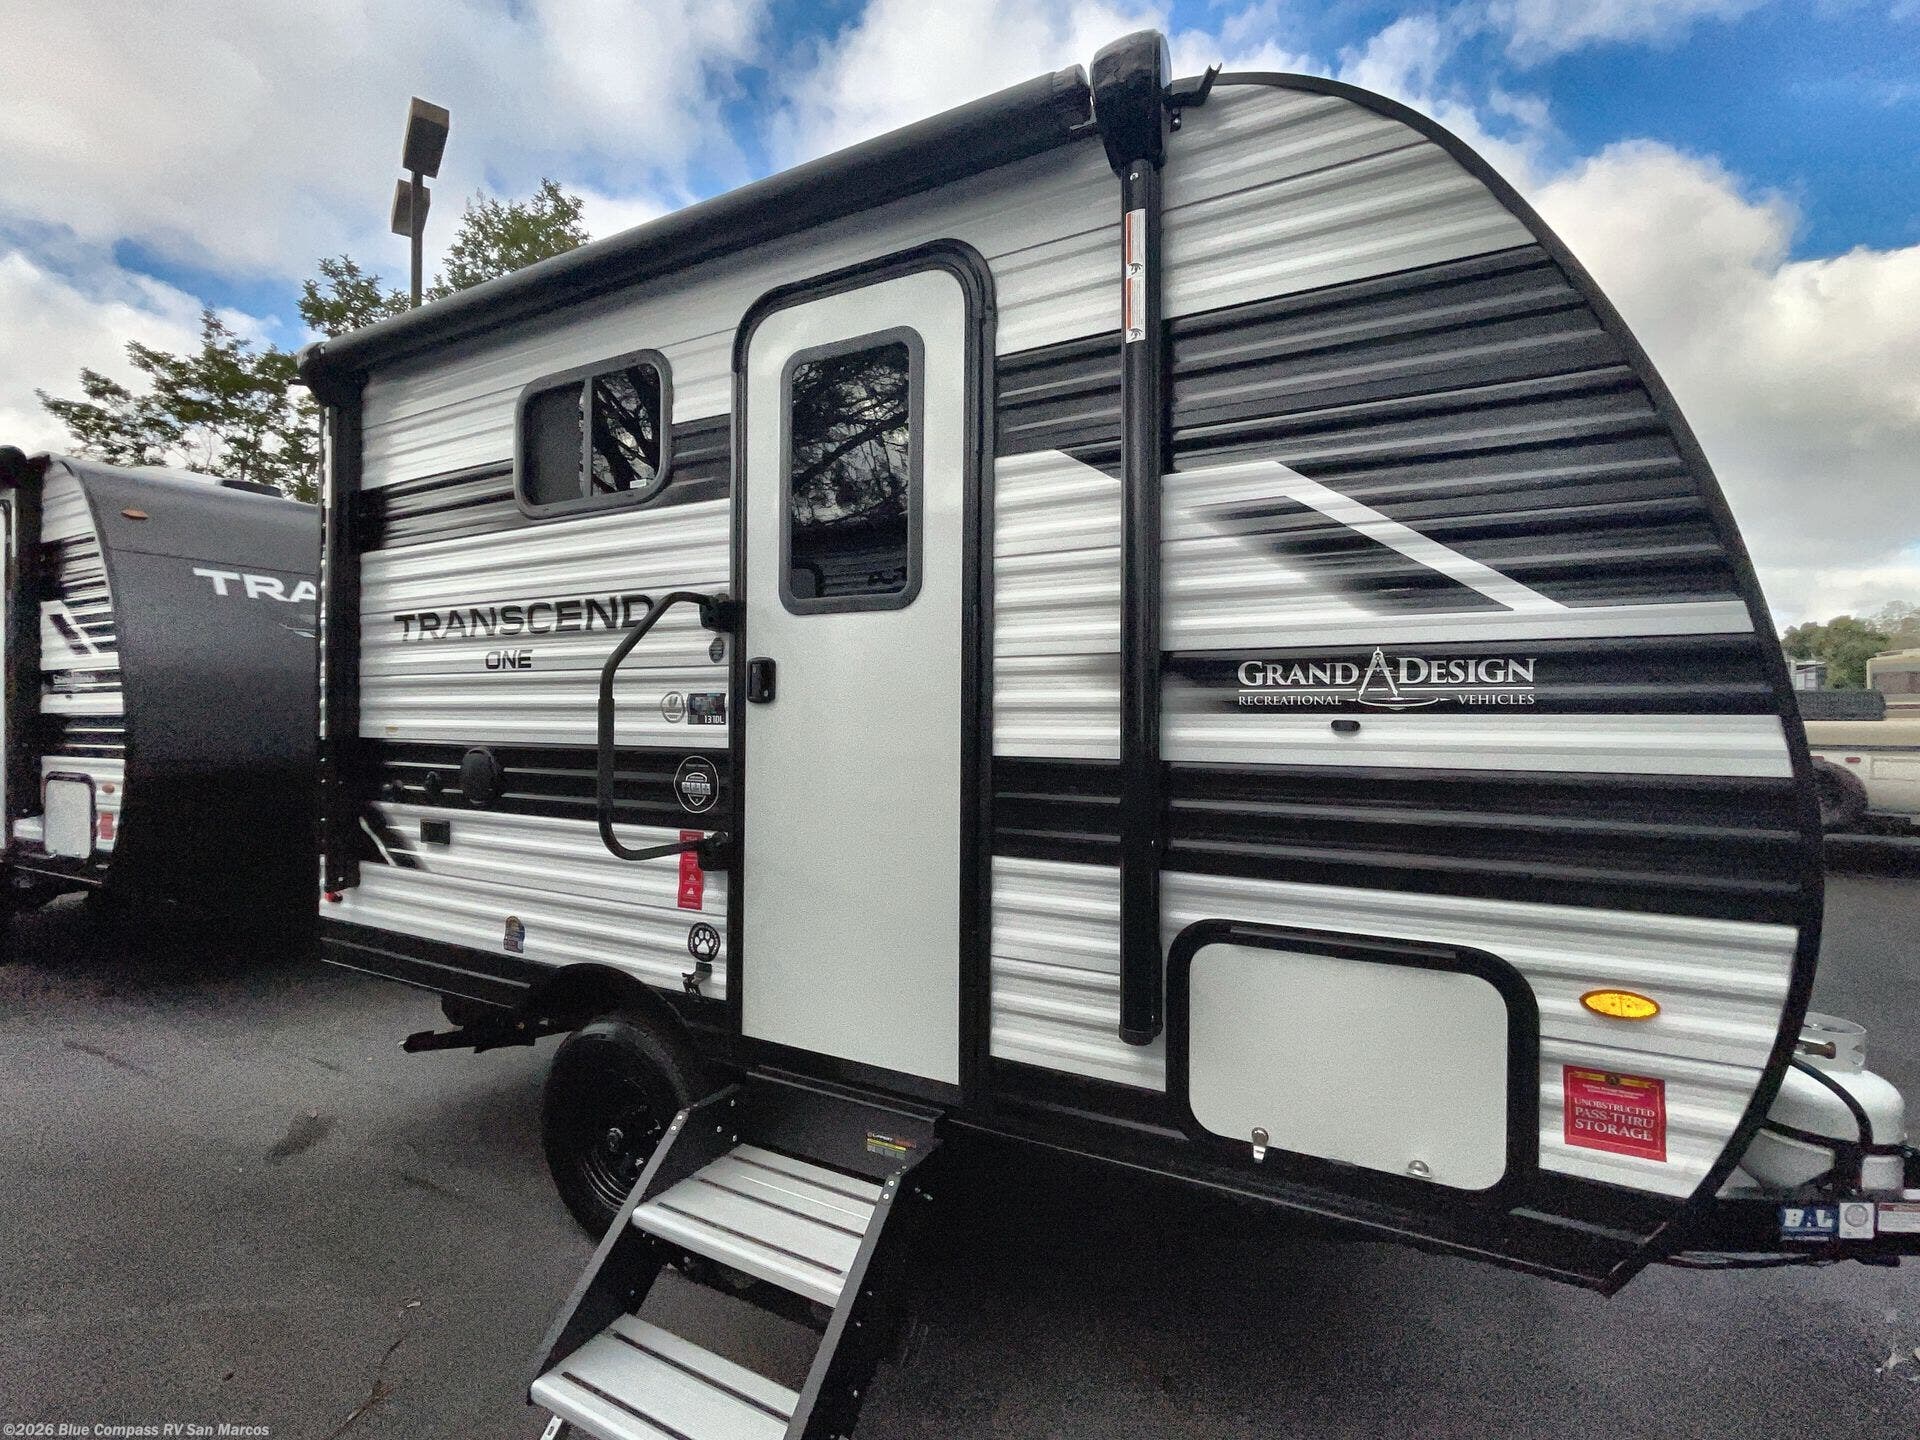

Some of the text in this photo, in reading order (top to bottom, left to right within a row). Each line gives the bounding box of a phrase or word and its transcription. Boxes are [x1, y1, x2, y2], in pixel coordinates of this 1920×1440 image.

[193, 567, 316, 602] TRA
[394, 594, 655, 641] TRANSCEND
[485, 649, 533, 669] ONE
[1237, 657, 1537, 686] GRAND DESIGN
[1238, 693, 1535, 706] RECREATIONAL VEHICLES
[1574, 1097, 1655, 1117] UNOBSTRUCTED
[1575, 1106, 1654, 1128] PASS-THRU
[1575, 1119, 1653, 1141] STORAGE
